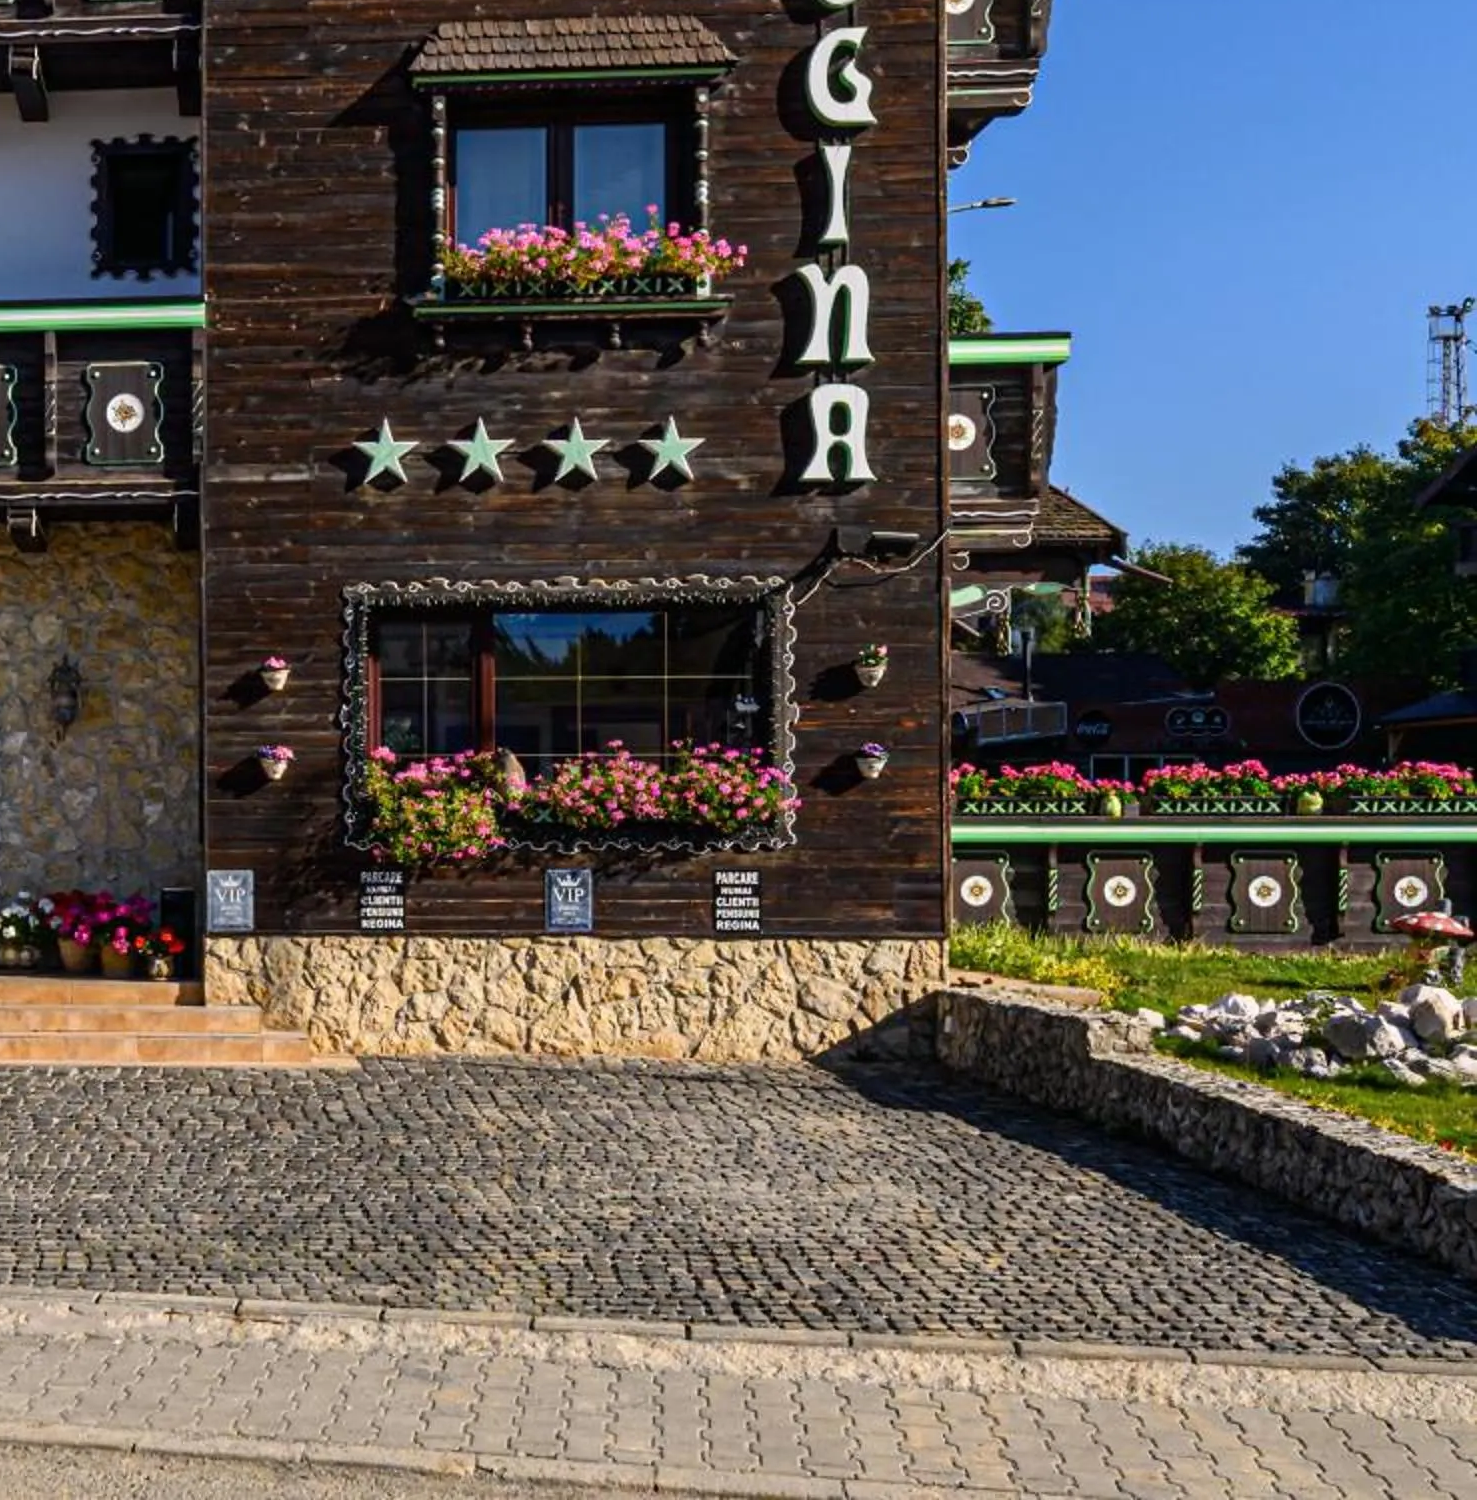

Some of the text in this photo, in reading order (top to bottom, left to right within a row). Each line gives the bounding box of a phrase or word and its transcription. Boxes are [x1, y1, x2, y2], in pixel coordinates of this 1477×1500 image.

[715, 871, 759, 885] PARCARE
[214, 887, 246, 902] VIP
[553, 886, 584, 902] VIP
[361, 918, 404, 929] REGINA
[716, 920, 760, 931] REGINA
